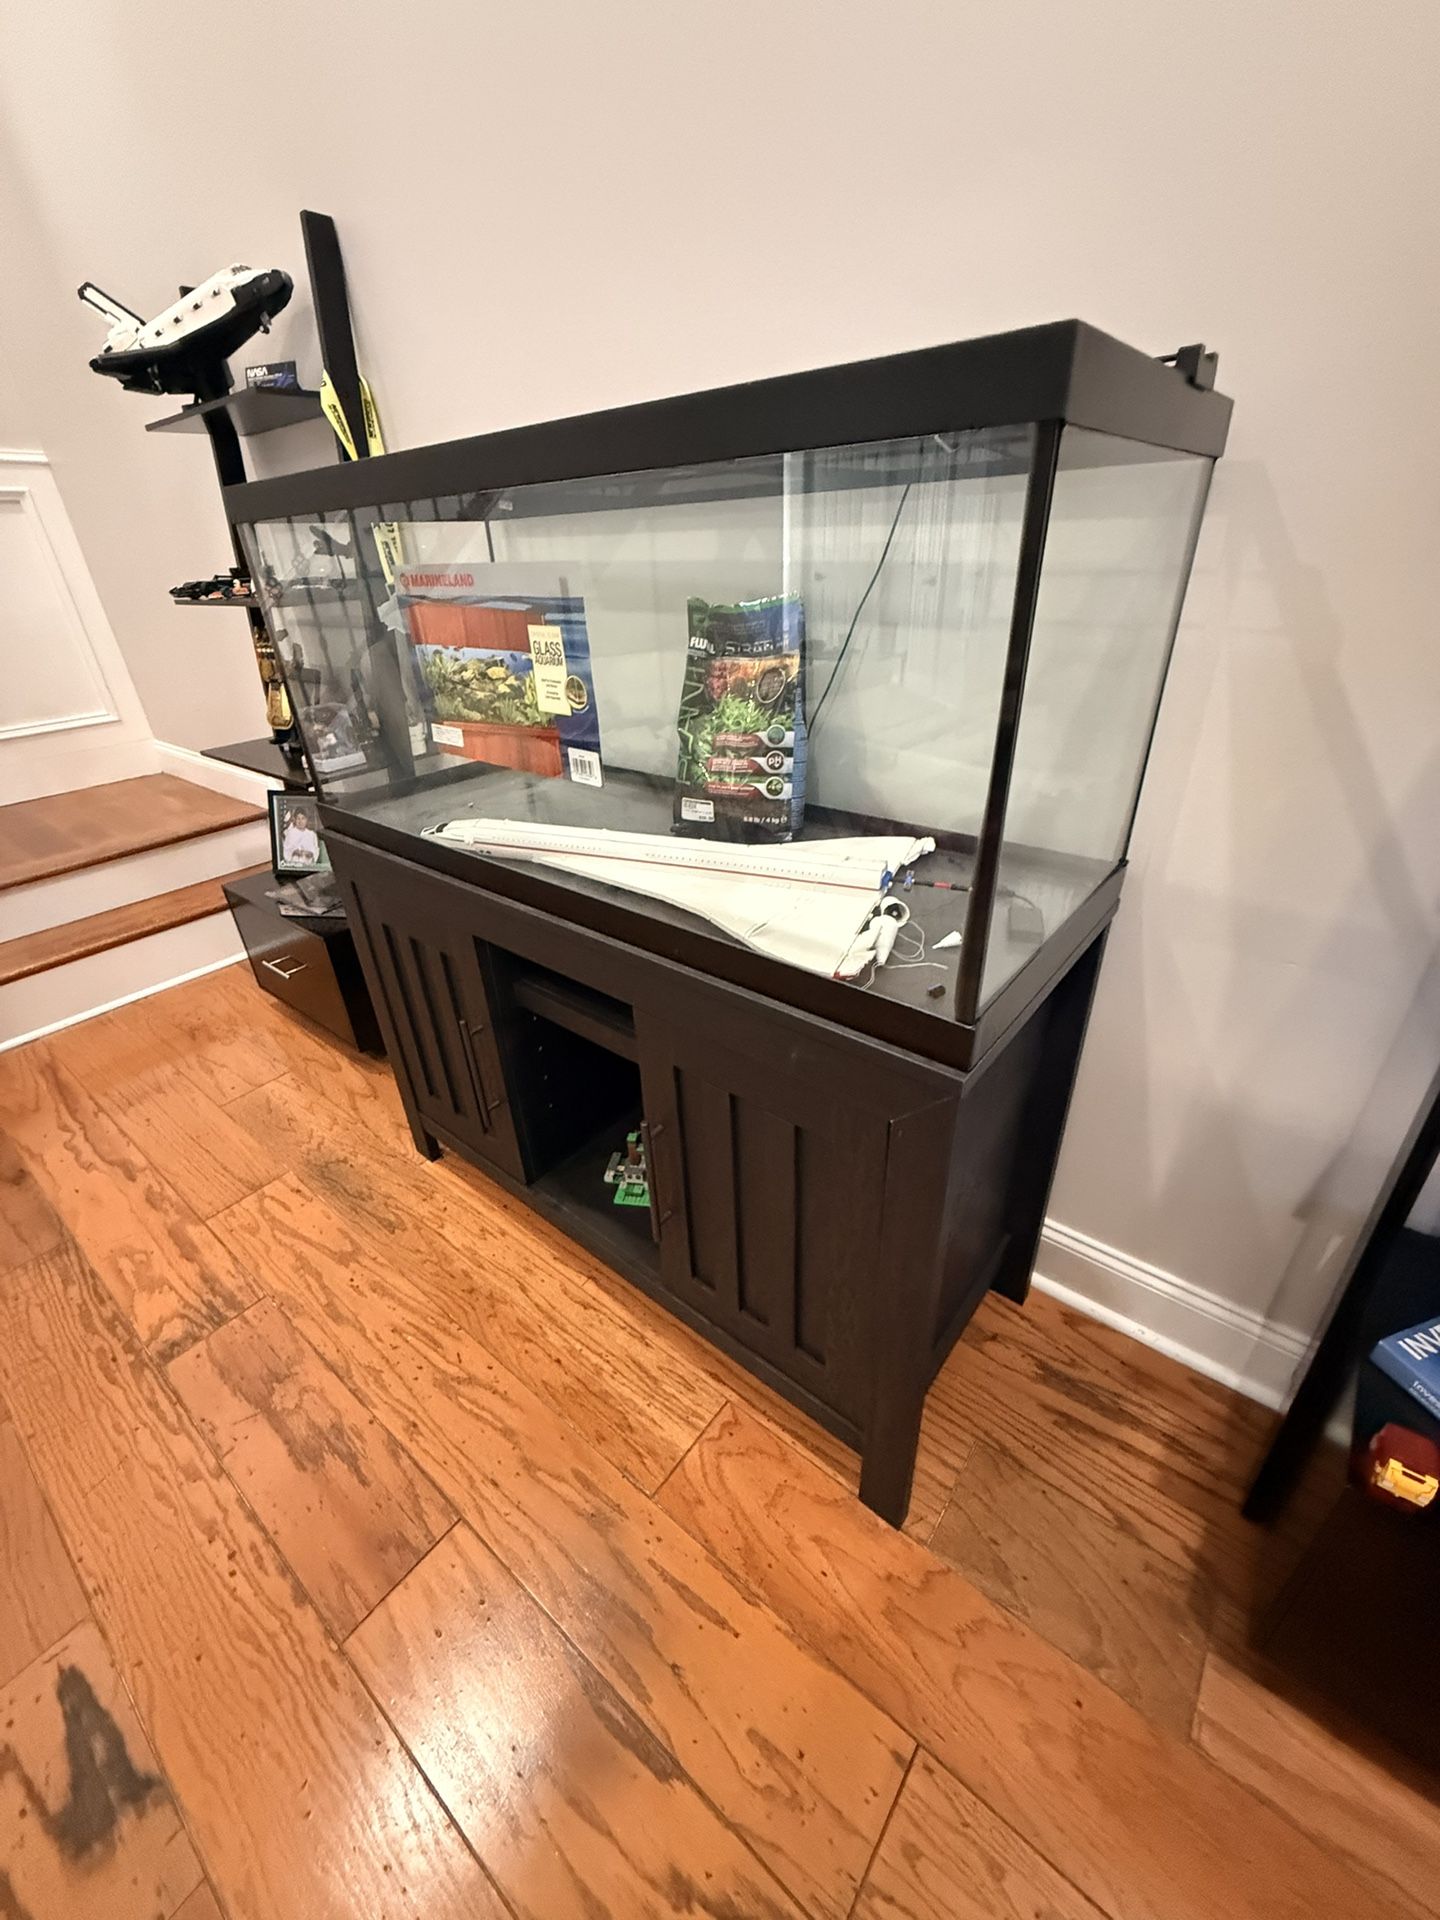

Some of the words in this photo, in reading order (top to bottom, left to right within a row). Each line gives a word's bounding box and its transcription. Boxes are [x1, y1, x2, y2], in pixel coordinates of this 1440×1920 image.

[246, 366, 268, 378] NASA
[410, 573, 474, 587] MARINELAND
[533, 640, 562, 657] GLASS
[689, 635, 716, 655] FLUL
[535, 655, 564, 667] AQUARIUM
